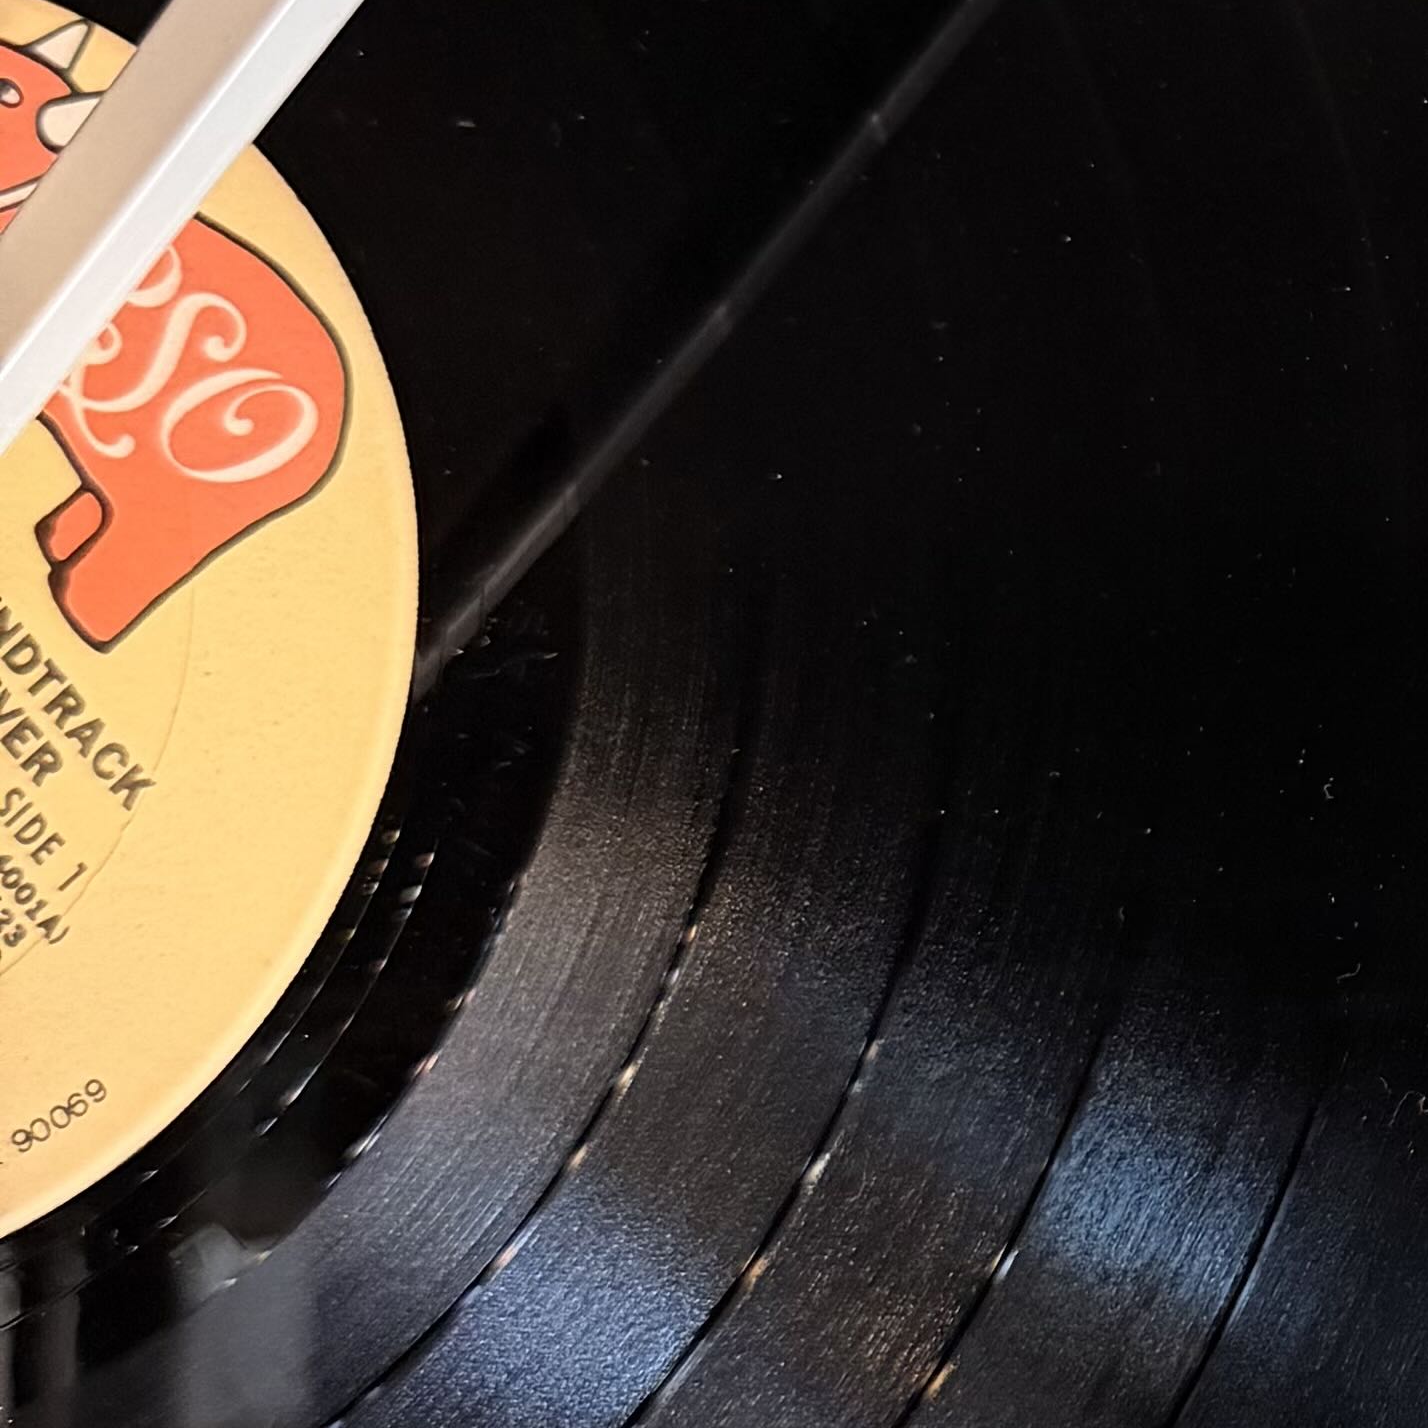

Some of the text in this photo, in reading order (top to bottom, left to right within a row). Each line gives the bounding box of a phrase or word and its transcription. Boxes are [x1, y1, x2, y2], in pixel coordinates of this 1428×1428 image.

[0, 787, 88, 892] SIDE 1
[11, 1078, 107, 1153] 90069
